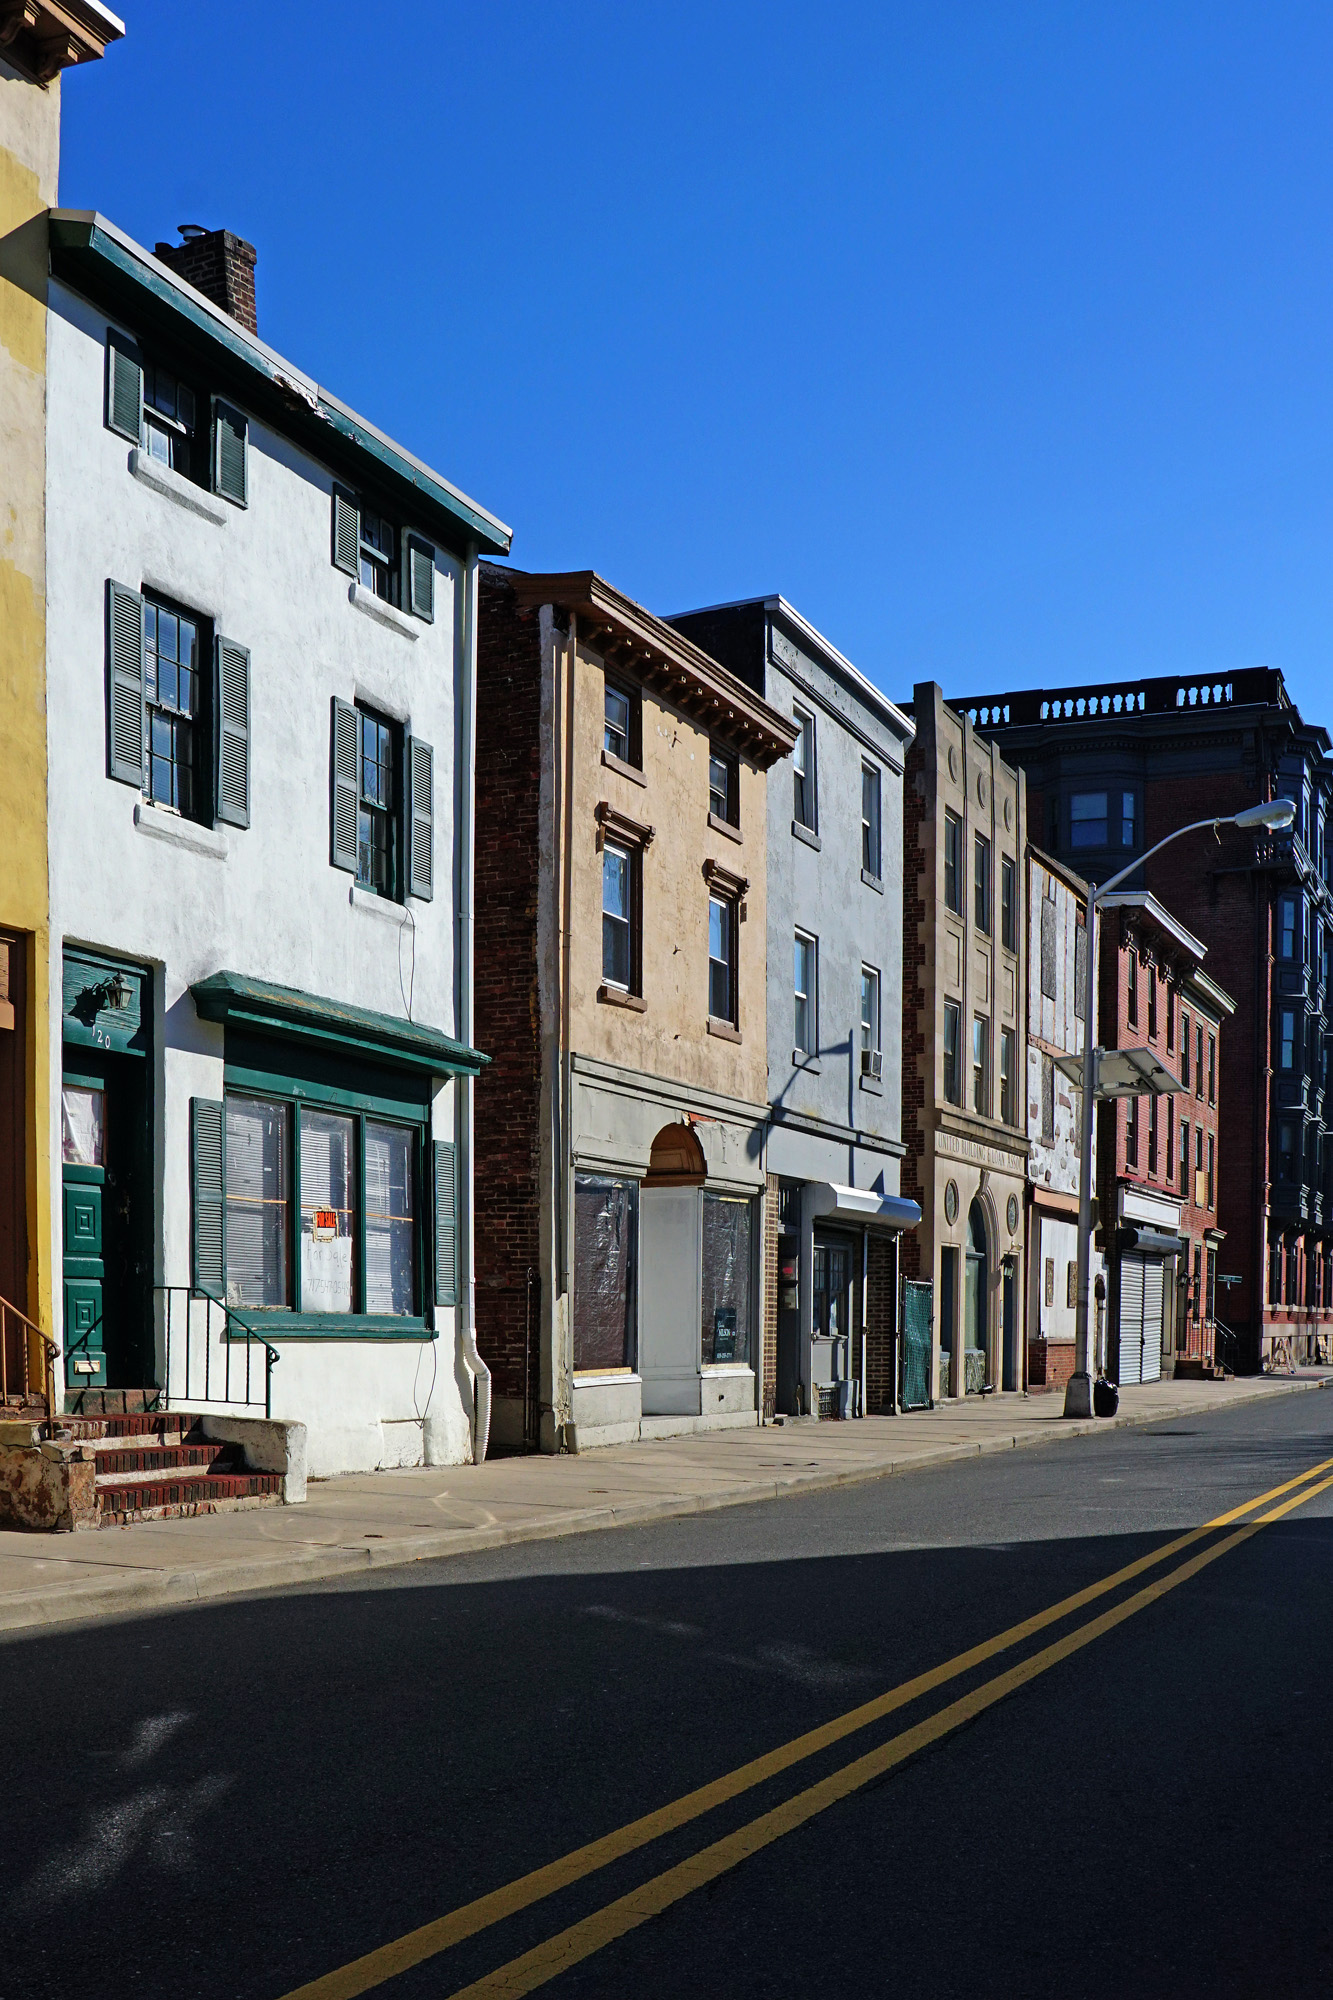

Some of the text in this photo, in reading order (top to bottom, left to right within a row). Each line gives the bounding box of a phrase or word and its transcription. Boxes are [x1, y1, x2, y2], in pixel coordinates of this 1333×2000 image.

[92, 1025, 111, 1048] 120
[938, 1132, 960, 1153] UNITED
[961, 1139, 986, 1161] BUILDING
[992, 1150, 1005, 1167] LOAN
[316, 1212, 336, 1227] FOR SALE
[307, 1239, 322, 1261] For
